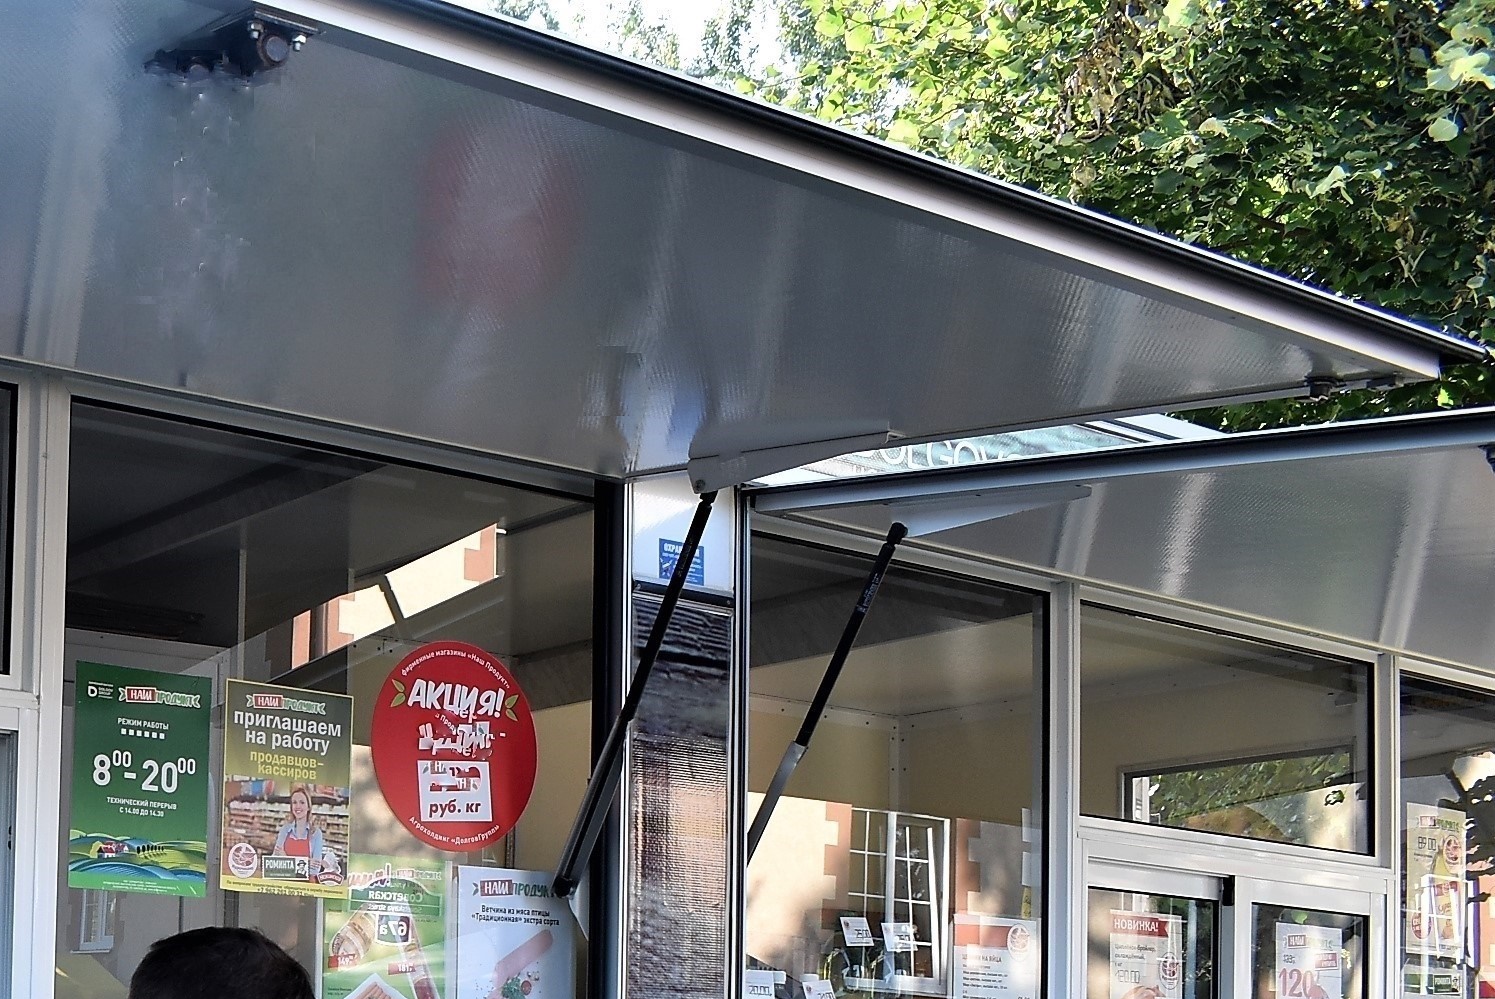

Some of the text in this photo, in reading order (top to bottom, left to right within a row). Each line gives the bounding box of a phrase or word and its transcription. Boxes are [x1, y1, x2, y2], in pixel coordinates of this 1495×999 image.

[401, 652, 435, 676] фирменные
[435, 649, 466, 658] магазины
[130, 689, 153, 701] НАШ
[258, 696, 279, 707] НАШ
[407, 678, 506, 720] АКЦИЯ!
[117, 717, 169, 730] РЕЖИМ РАБОТЫ
[234, 710, 341, 737] приглашаем
[245, 729, 330, 756] на работу
[250, 751, 324, 769] продавцов-
[258, 764, 317, 780] кассиров
[107, 796, 177, 810] ТЕХНИЧЕСКИЙ ПЕРЕРЫВ
[428, 799, 481, 818] руб. кг
[409, 816, 450, 843] Агрохолдинг
[265, 859, 295, 869] РОМИНТА
[484, 881, 554, 897] НАШ ПРОДУК
[481, 905, 507, 914] Ветчина
[472, 912, 560, 926] «Традиционная» экстра сорта
[1114, 919, 1159, 932] НОВИНКА!
[1279, 967, 1313, 998] 120
